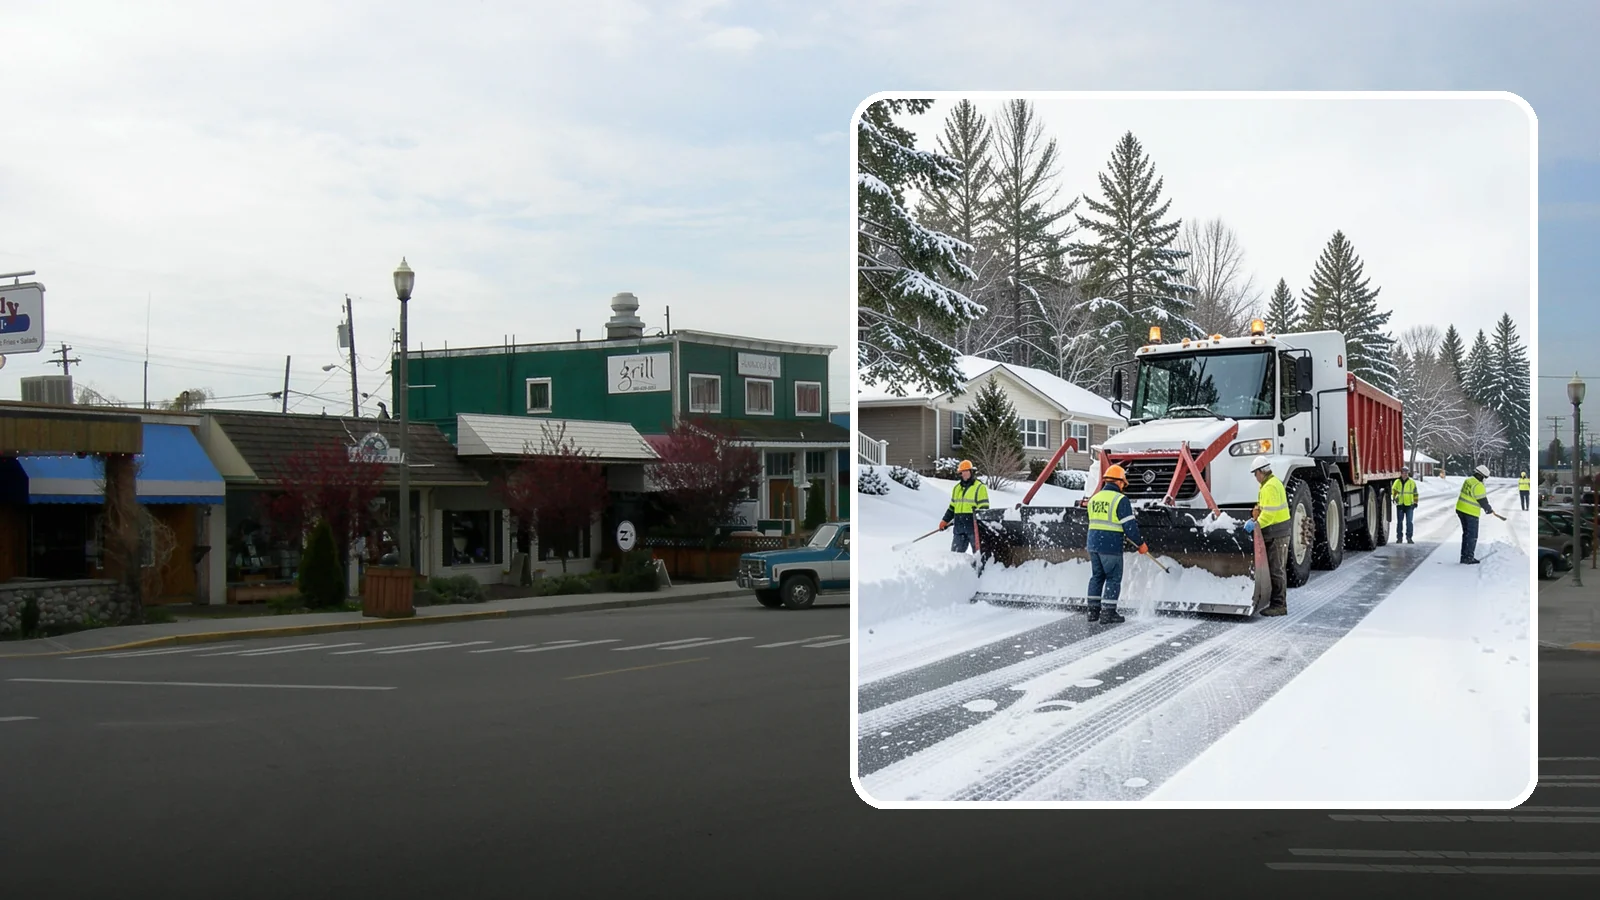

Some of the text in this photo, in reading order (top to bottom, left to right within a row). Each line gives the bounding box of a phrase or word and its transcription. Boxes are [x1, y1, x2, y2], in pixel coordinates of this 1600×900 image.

[3, 338, 16, 346] Fries
[20, 336, 38, 345] Salads
[617, 355, 655, 391] grill
